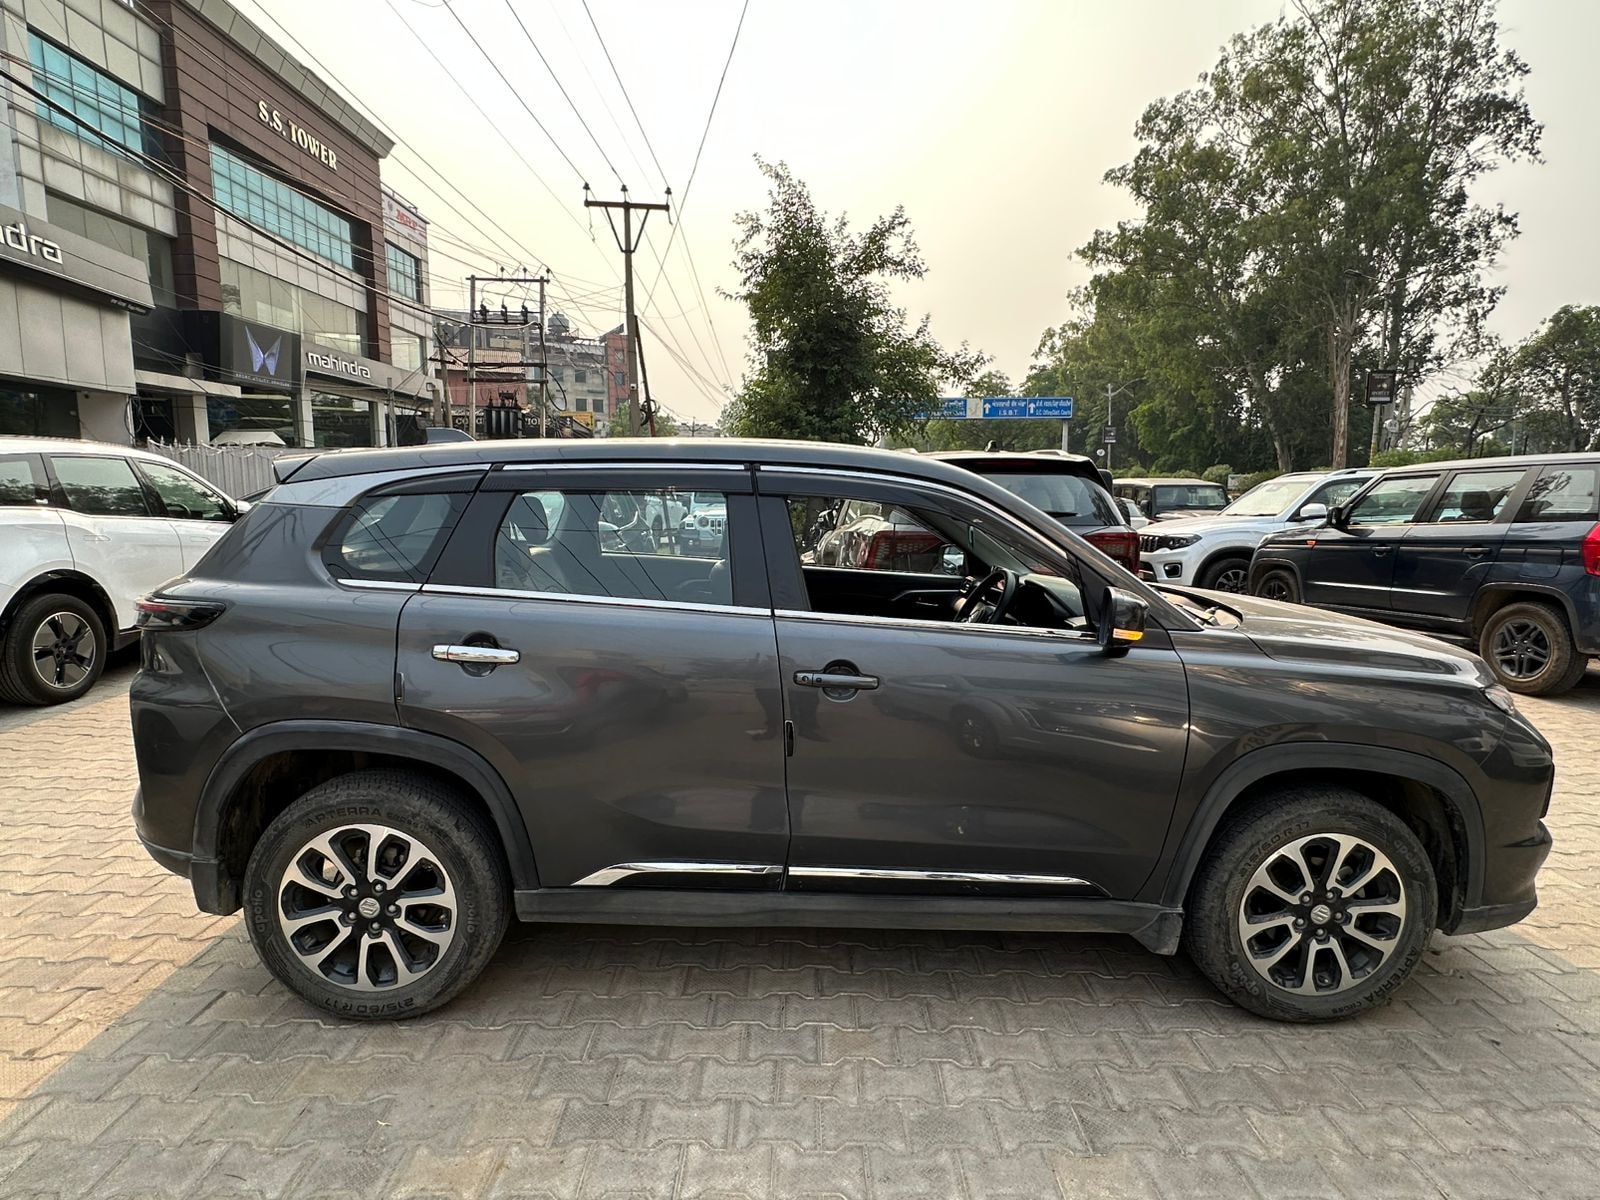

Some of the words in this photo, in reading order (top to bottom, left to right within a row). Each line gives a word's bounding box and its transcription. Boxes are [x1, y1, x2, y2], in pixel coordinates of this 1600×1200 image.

[258, 100, 286, 136] S.S.
[288, 119, 337, 171] TOWER
[307, 351, 372, 379] mahindra
[303, 806, 382, 828] APTERRA
[250, 889, 269, 933] apollo
[1362, 945, 1417, 1004] APTERRA
